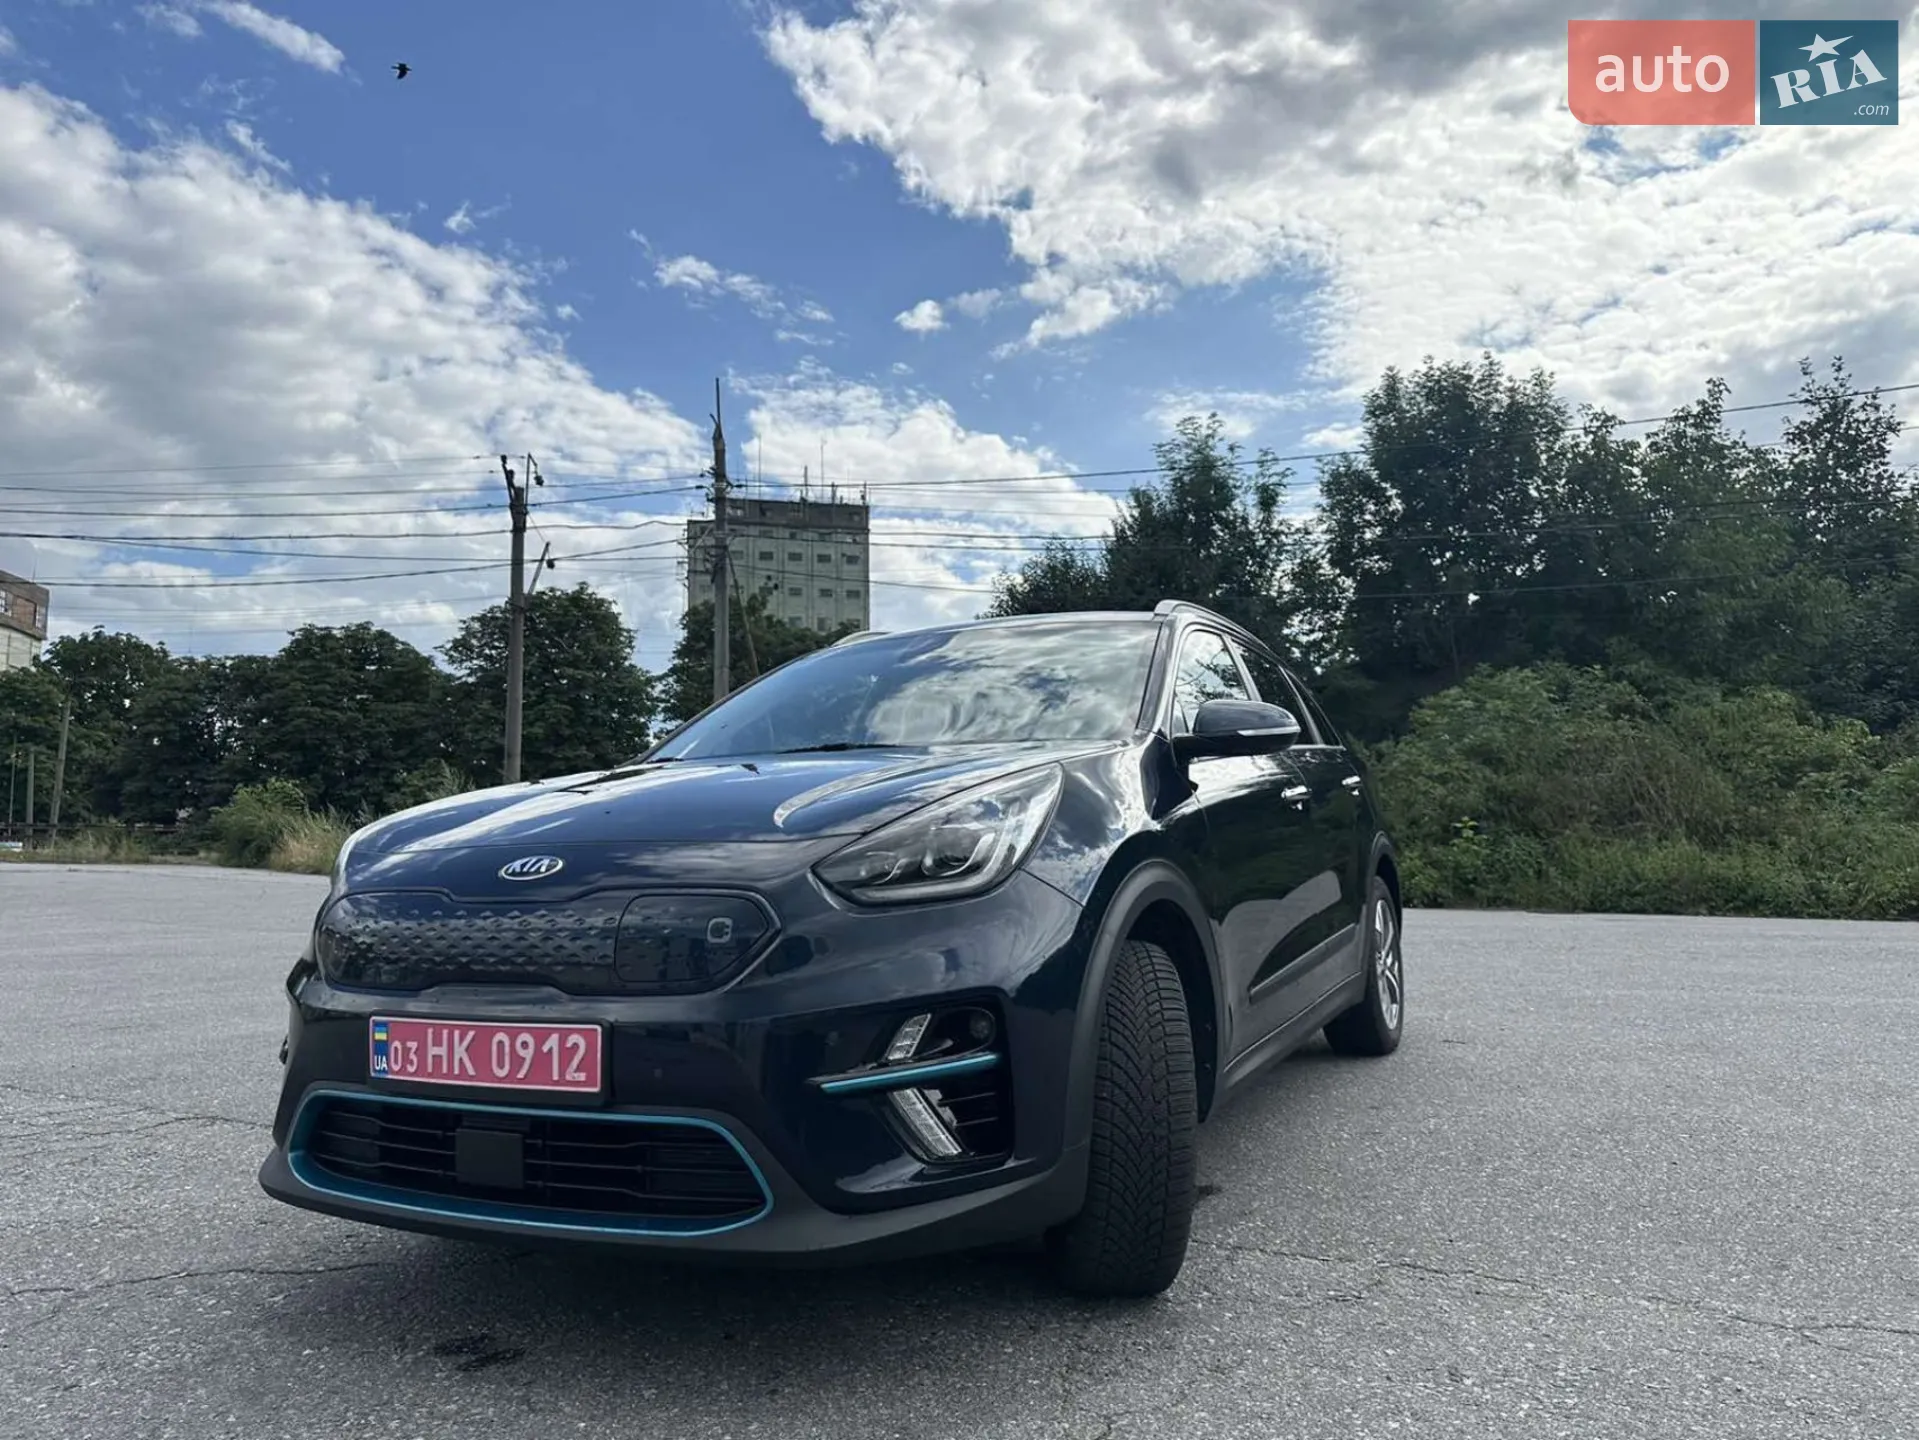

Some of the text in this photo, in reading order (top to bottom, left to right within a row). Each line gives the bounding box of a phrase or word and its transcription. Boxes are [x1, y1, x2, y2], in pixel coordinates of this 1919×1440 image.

[507, 857, 550, 874] KIA
[374, 1055, 388, 1071] UA
[390, 1028, 586, 1082] 03 HK 0912
